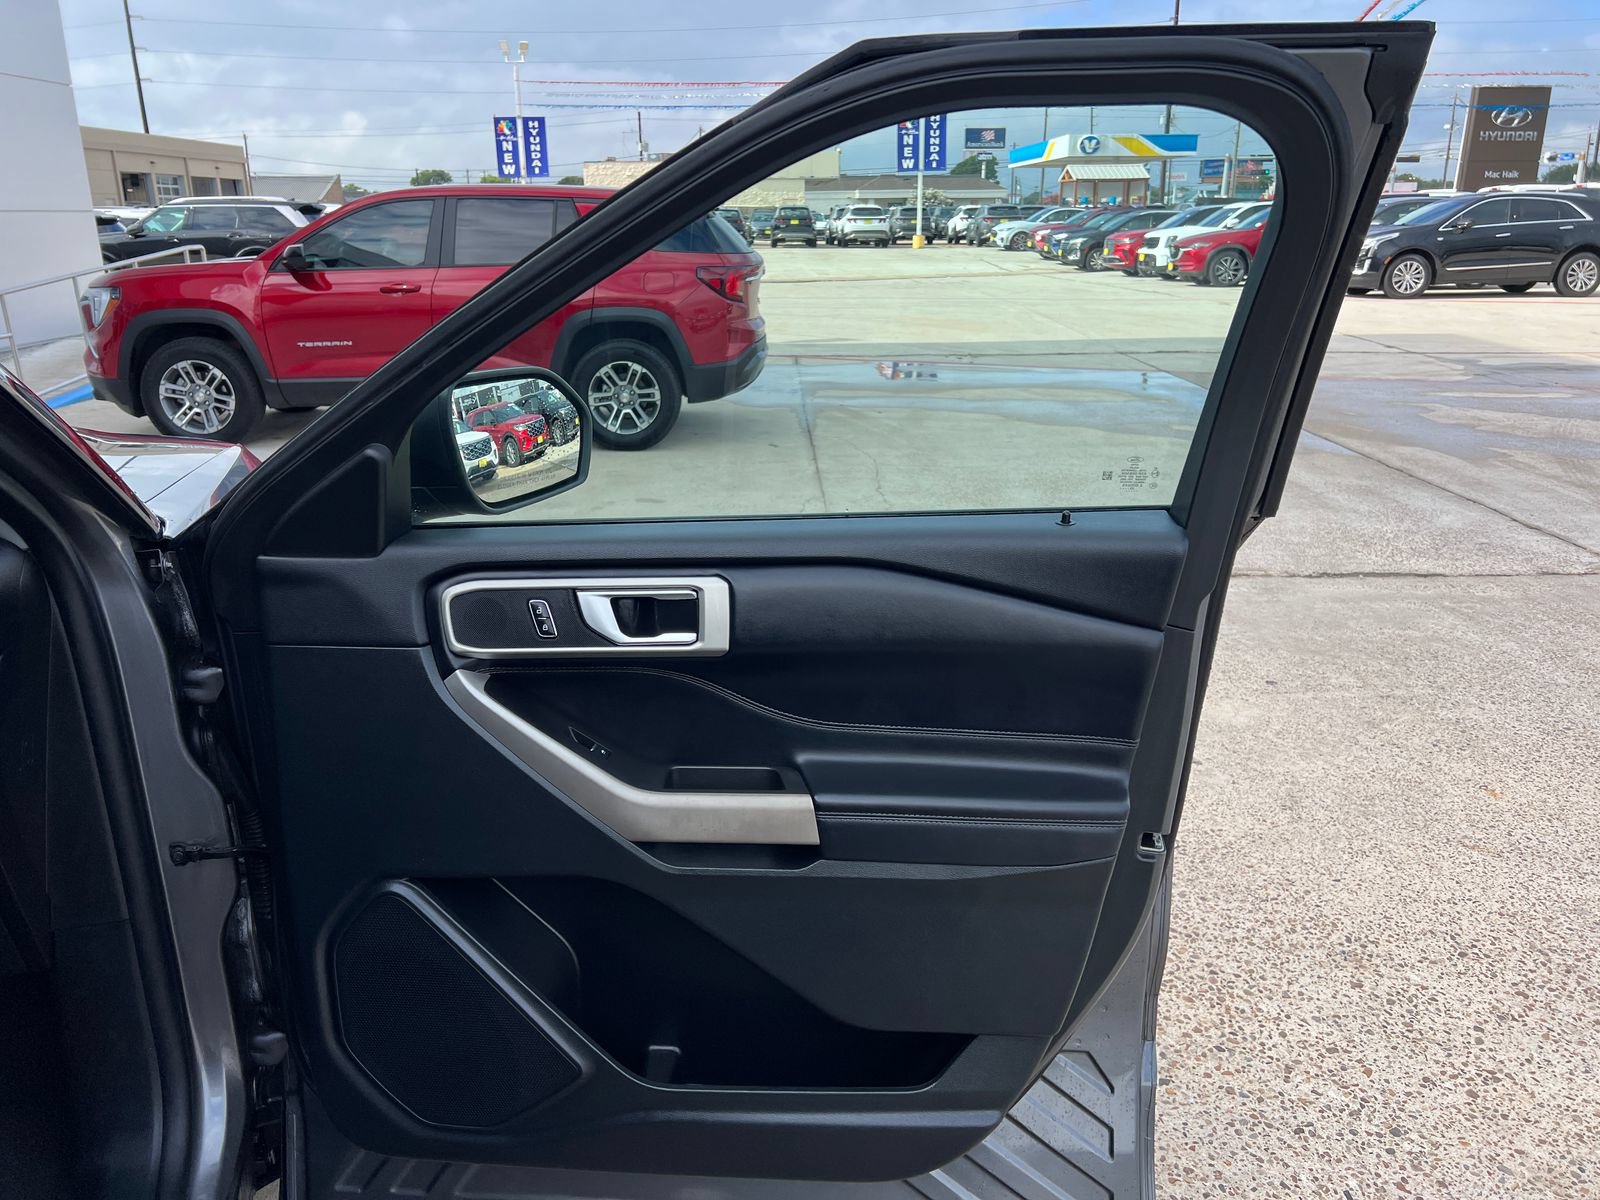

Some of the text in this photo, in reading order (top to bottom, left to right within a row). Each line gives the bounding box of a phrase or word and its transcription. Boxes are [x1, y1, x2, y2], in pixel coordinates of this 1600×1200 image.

[528, 120, 542, 175] HYUNDAI
[1479, 130, 1538, 142] HYUNDAI
[501, 140, 516, 175] NEW
[901, 134, 915, 169] NEW
[1484, 170, 1520, 179] Mac Haik
[296, 340, 353, 348] TERRAIN
